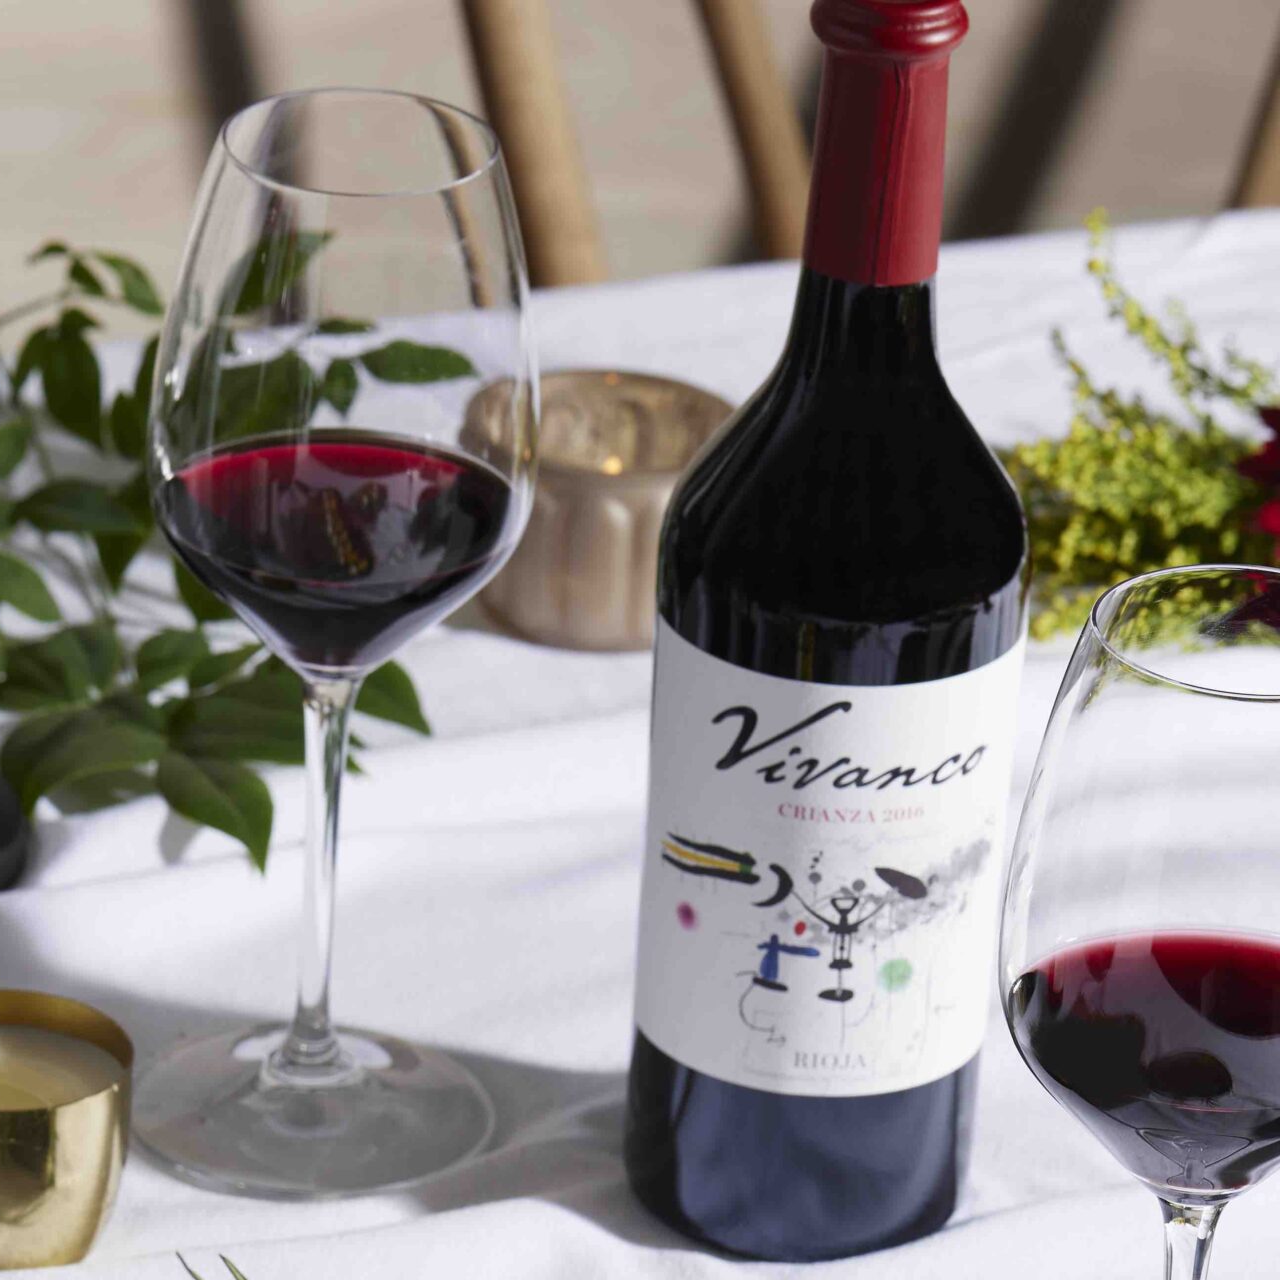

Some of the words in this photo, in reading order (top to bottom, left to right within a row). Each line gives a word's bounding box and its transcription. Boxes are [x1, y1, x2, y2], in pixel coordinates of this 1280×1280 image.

[712, 701, 989, 790] Vivanco
[777, 802, 876, 824] CRIANZA
[793, 1052, 867, 1069] RIOJA
